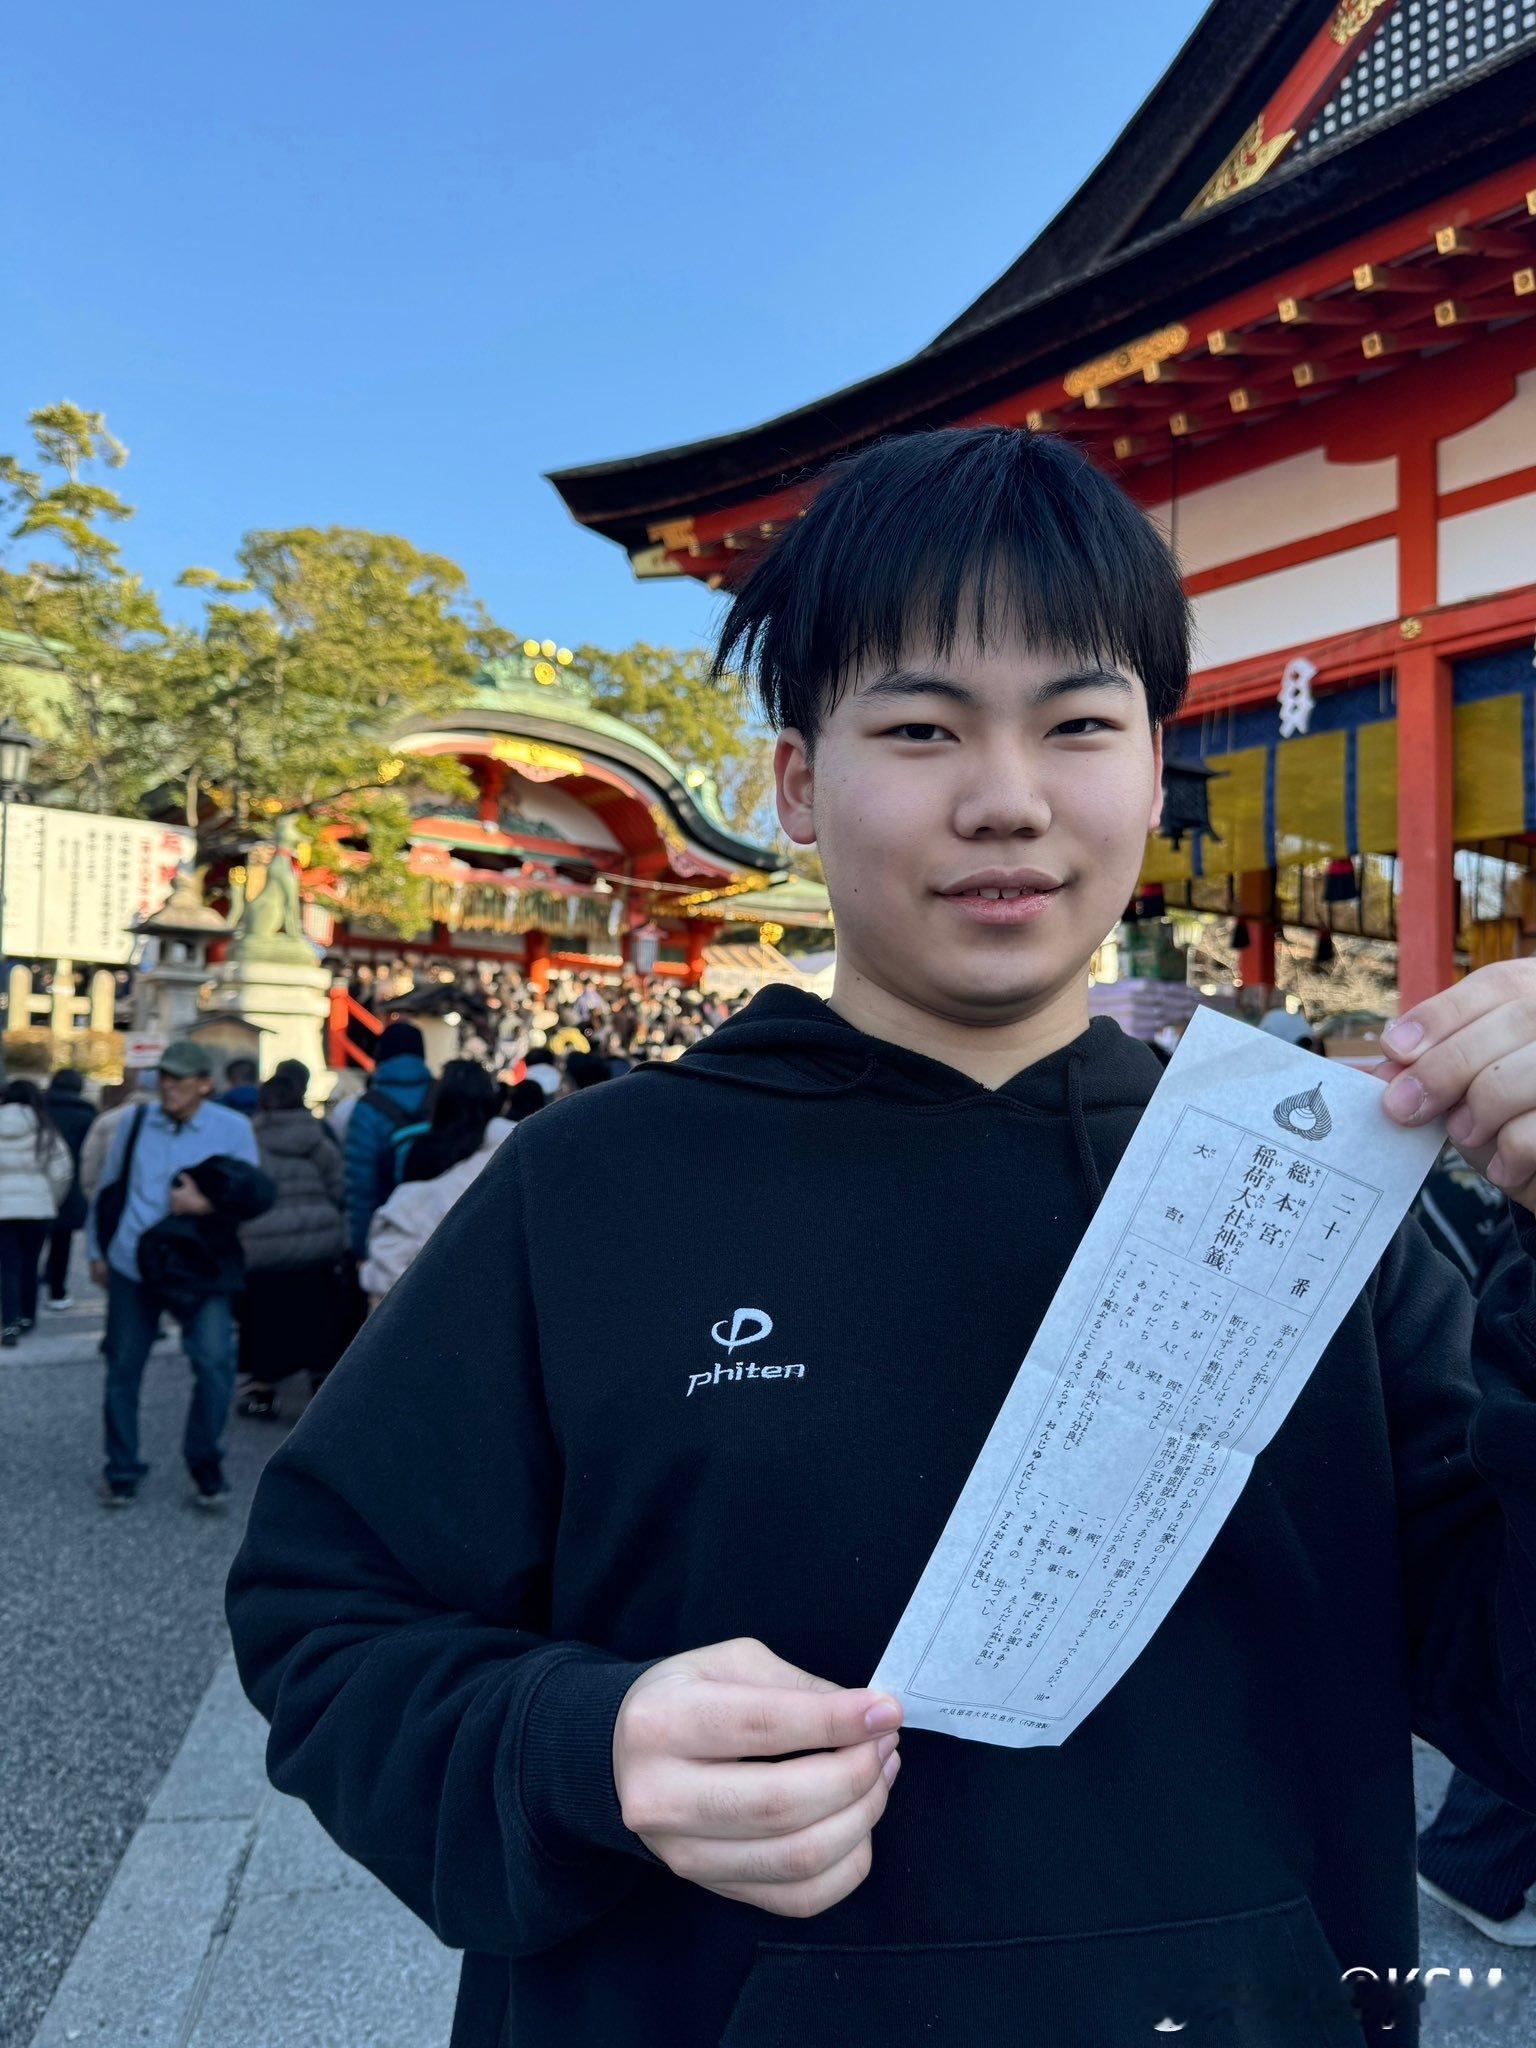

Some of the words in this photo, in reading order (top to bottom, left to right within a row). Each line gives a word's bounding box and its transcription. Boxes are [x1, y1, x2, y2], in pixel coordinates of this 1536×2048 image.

[1163, 1142, 1211, 1221] 大吉
[1200, 1144, 1277, 1271] 稲荷大社神籤
[1256, 1160, 1313, 1245] 総本宮
[1288, 1193, 1358, 1298] 二十一番
[686, 1361, 805, 1397] phiten
